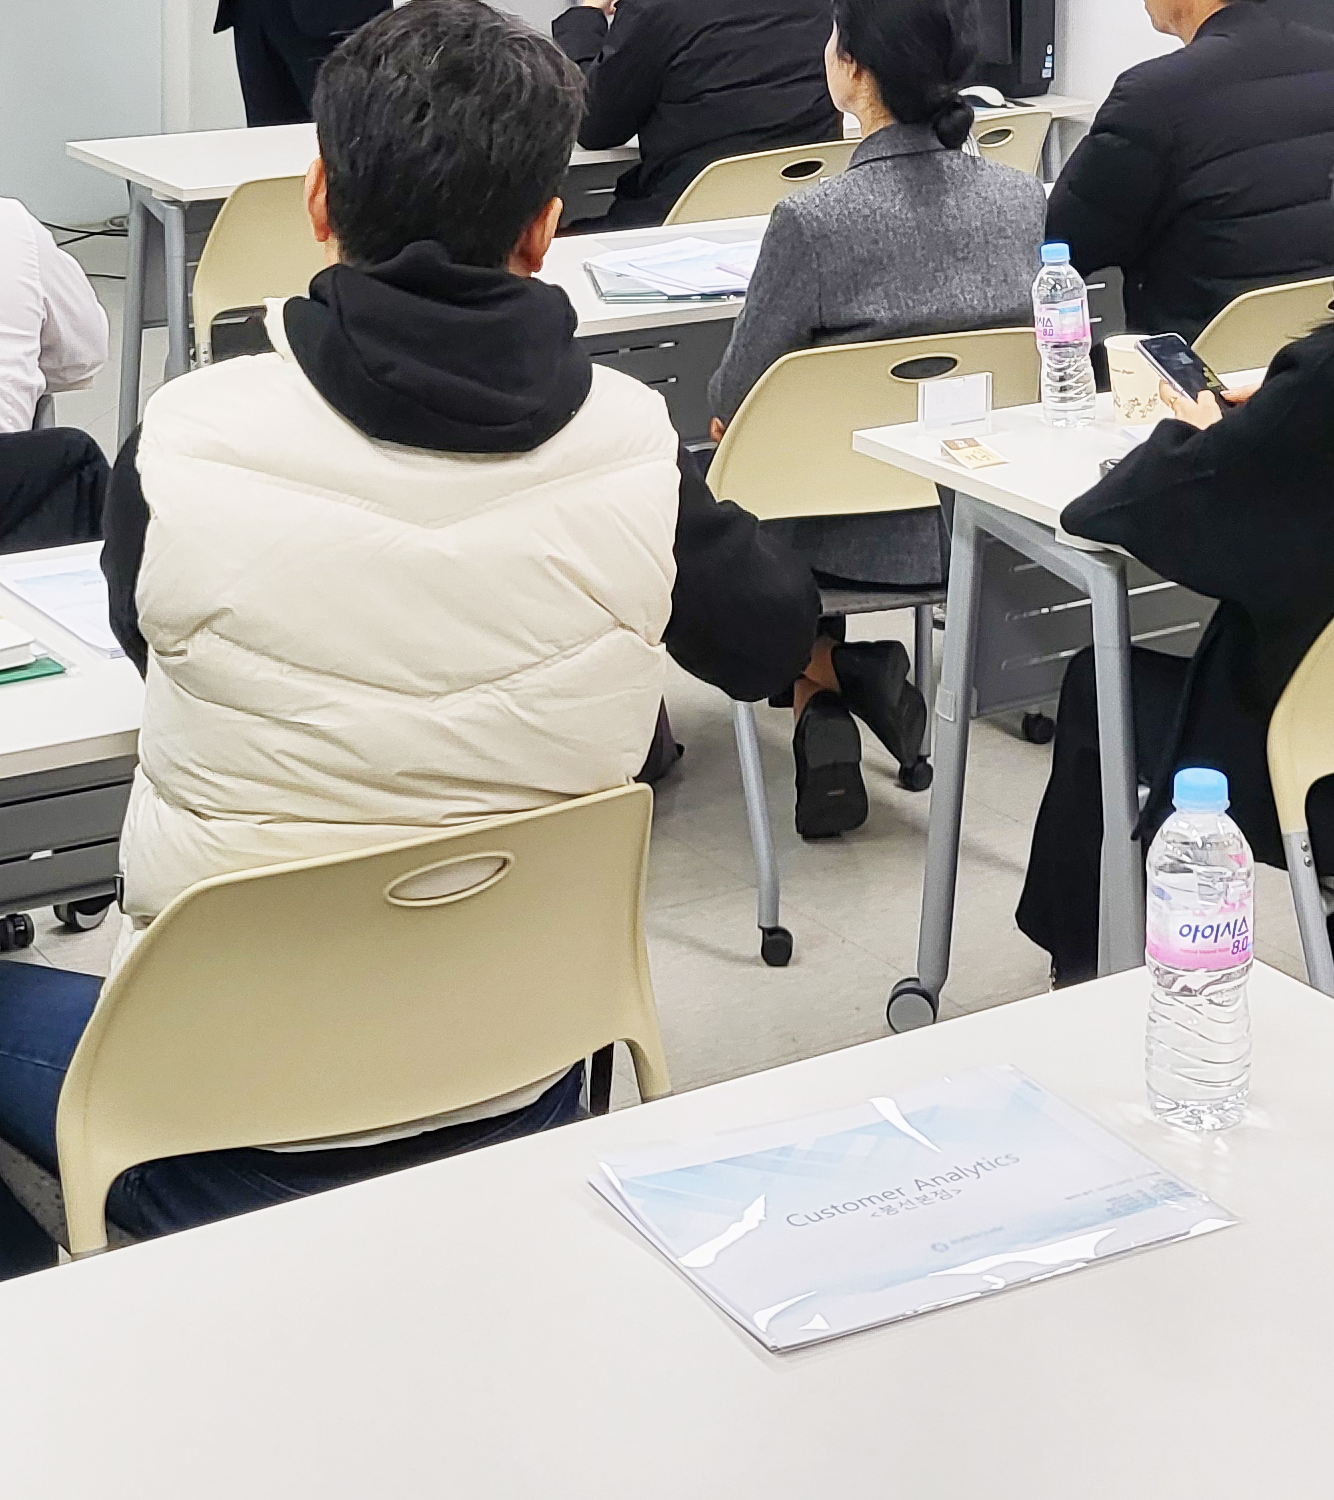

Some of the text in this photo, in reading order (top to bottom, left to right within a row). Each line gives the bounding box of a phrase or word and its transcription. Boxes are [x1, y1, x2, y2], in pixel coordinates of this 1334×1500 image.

[1178, 915, 1249, 944] 아이시스
[1230, 935, 1249, 955] 8.0
[785, 1150, 1021, 1229] Customer Analytics
